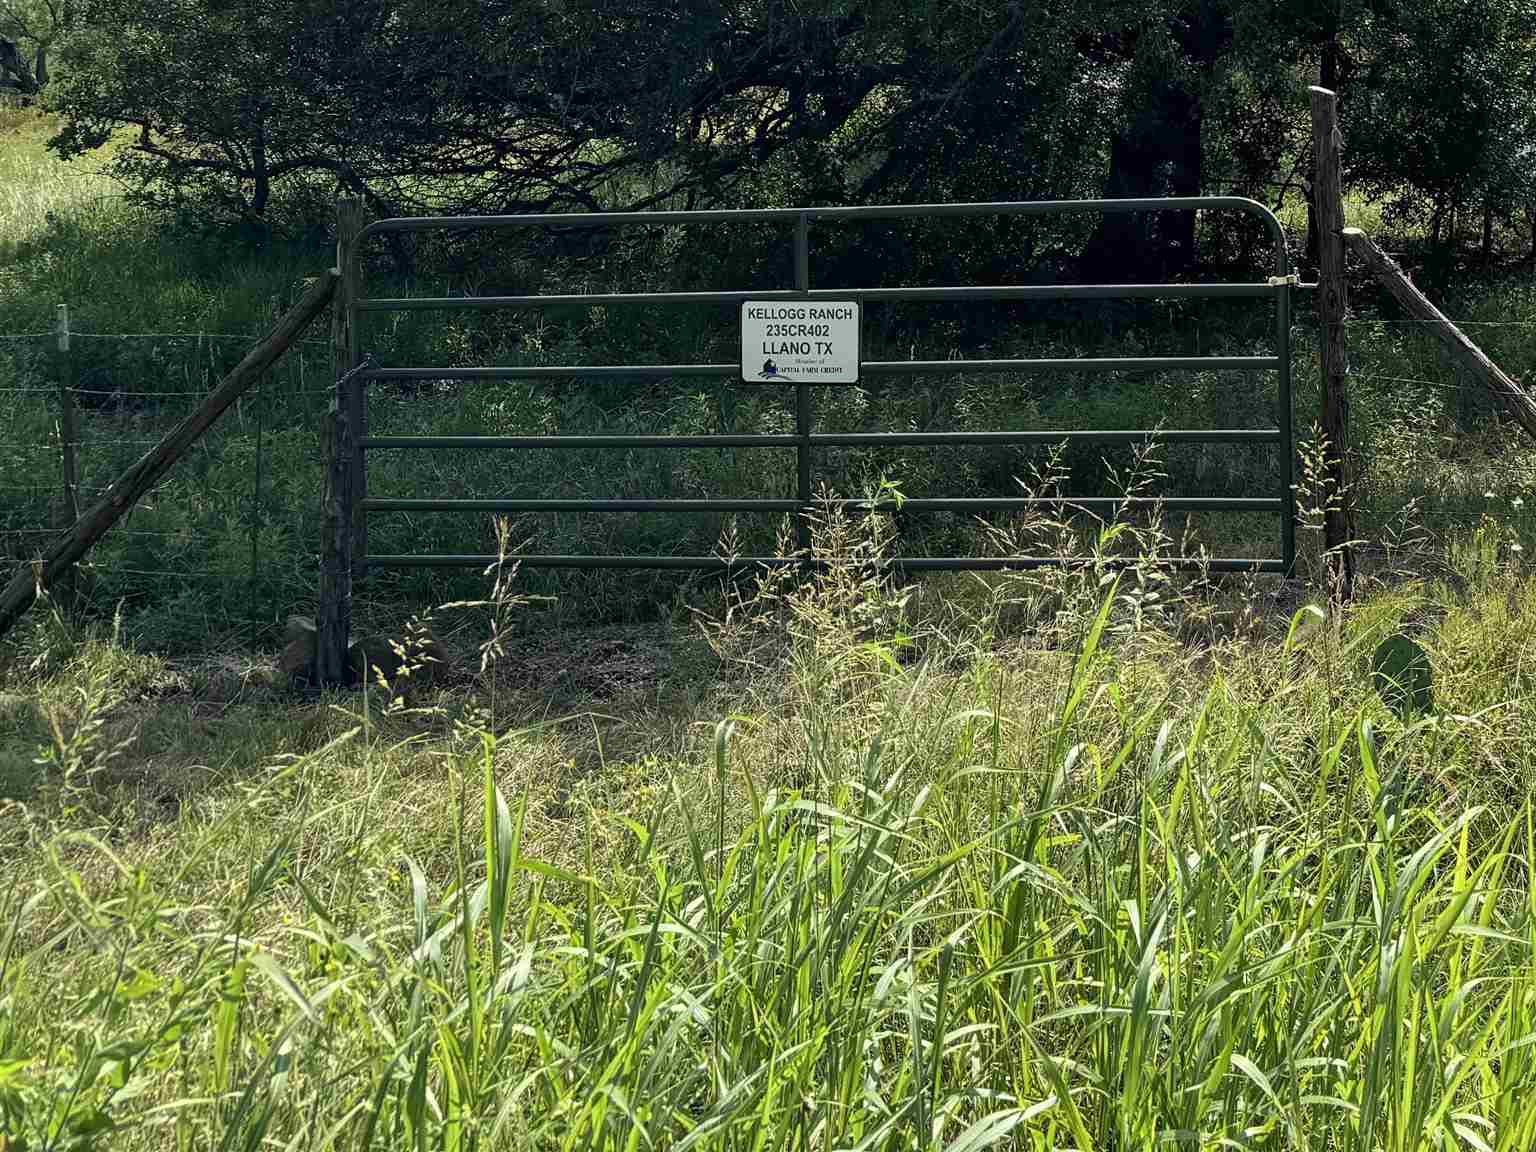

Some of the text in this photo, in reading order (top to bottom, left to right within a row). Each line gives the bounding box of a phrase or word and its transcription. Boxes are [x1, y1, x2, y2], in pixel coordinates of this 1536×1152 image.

[747, 307, 853, 320] KELLOGG RANCH
[766, 324, 830, 337] 235CR402
[762, 341, 833, 355] LLANO TX
